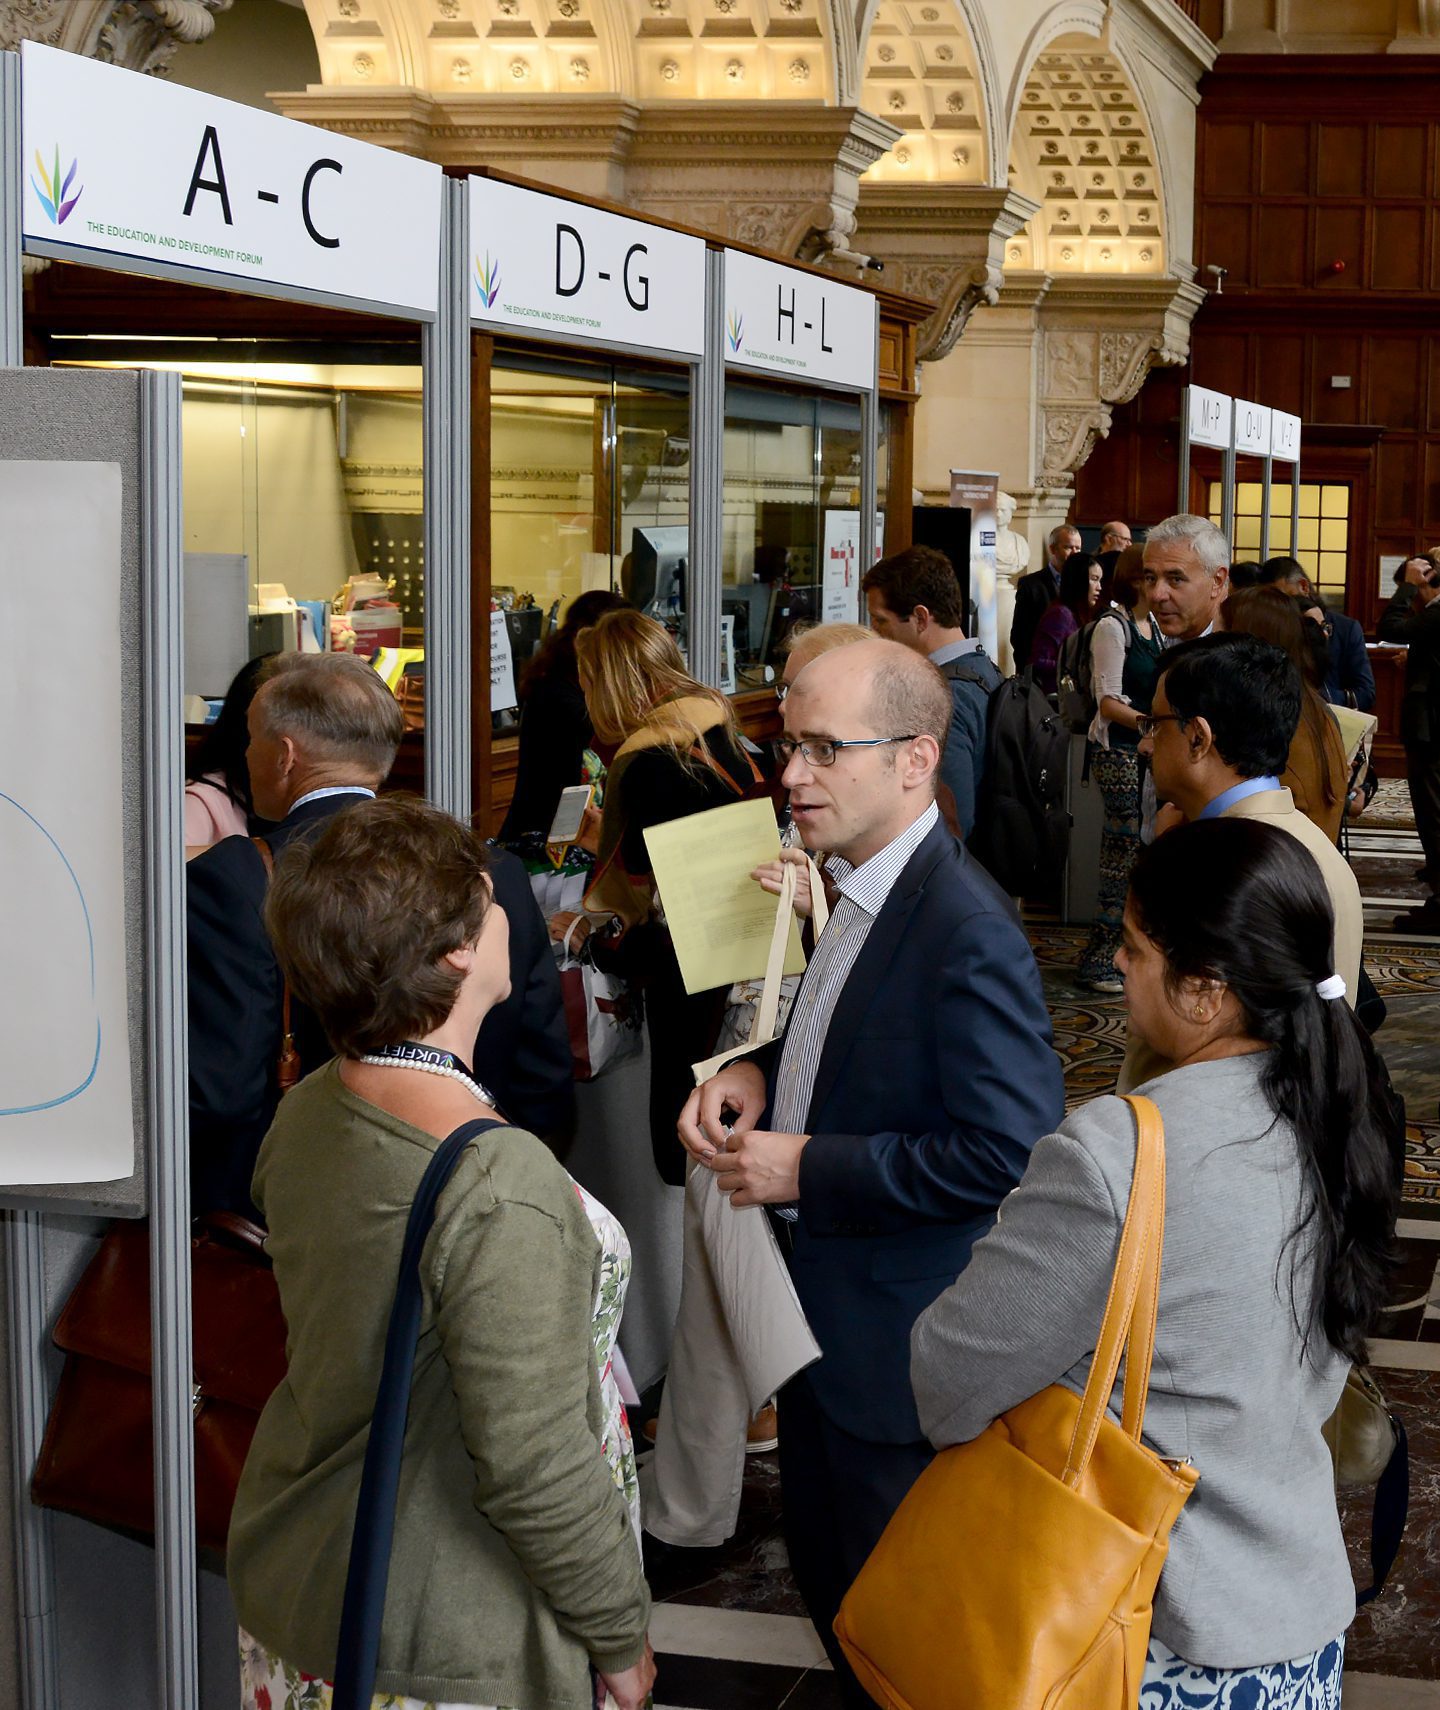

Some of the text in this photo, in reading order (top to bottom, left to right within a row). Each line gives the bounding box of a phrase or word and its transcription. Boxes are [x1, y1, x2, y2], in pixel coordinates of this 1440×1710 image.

[87, 221, 263, 265] THE EDUCATION AND DEVELOPMENT FORUM
[379, 1044, 441, 1063] UKFIET
